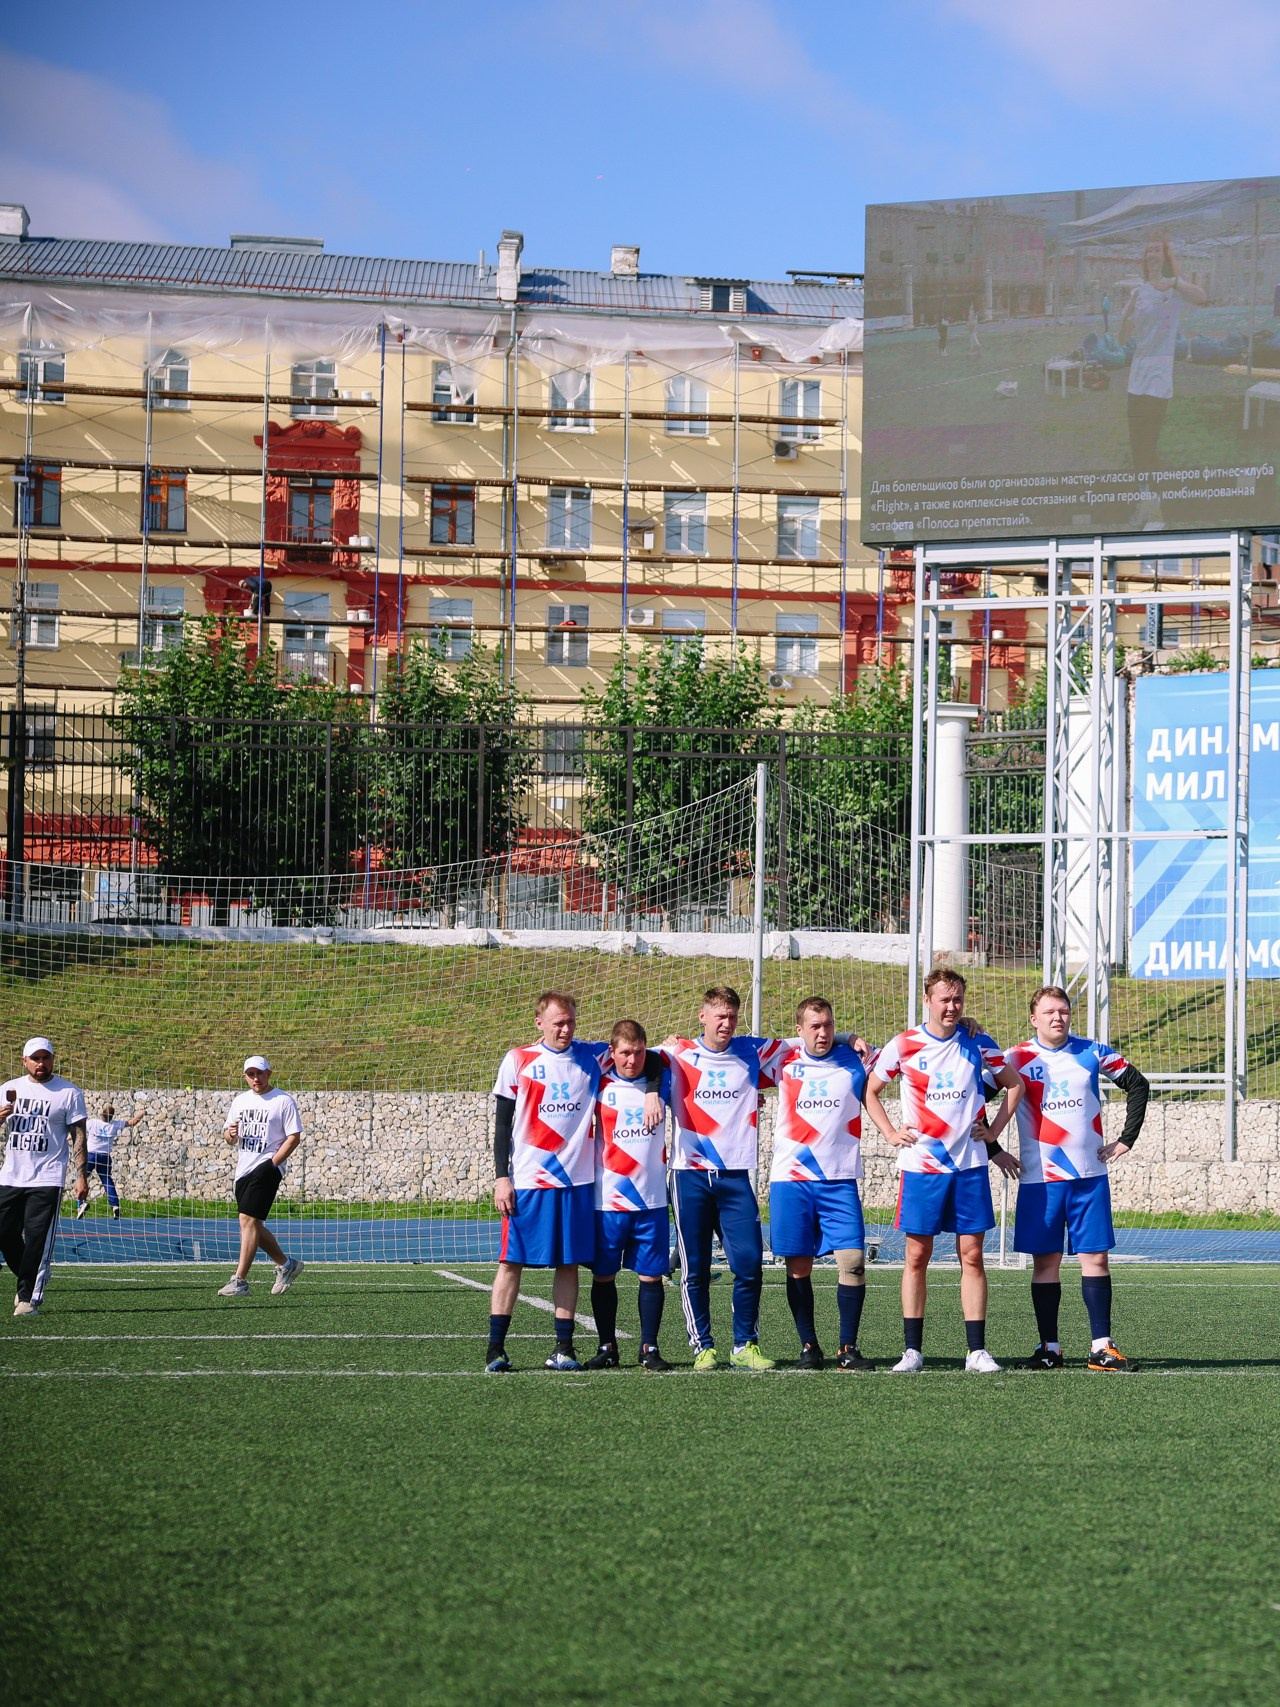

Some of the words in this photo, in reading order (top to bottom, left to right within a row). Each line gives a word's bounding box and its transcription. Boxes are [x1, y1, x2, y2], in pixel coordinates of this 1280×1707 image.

[871, 480, 890, 495] Для
[893, 479, 958, 493] болельщиков
[961, 476, 986, 489] были
[989, 474, 1059, 491] организованы
[1061, 470, 1136, 487] мастер-классы
[1138, 472, 1149, 481] от
[1152, 468, 1200, 483] тренеров
[1202, 463, 1274, 481] фитнес-клуба
[922, 500, 950, 510] также
[952, 497, 1018, 510] комплексные
[1021, 494, 1077, 506] состязания
[1080, 490, 1115, 506] «Тропа
[1162, 486, 1255, 501] комбинированная
[870, 520, 914, 533] эстафета
[916, 517, 959, 530] «Полоса
[962, 513, 1033, 530] препятствий».
[1146, 769, 1242, 801] МИЛ
[693, 1052, 701, 1066] 7
[918, 1056, 928, 1071] 6
[532, 1064, 546, 1080] 13
[792, 1063, 806, 1079] 15
[1029, 1065, 1044, 1081] 12
[607, 1092, 617, 1106] 9
[694, 1090, 739, 1099] КОМОС
[926, 1089, 967, 1101] КОМОС
[13, 1098, 52, 1117] NJOY
[539, 1102, 582, 1113] КОМОС
[796, 1098, 841, 1110] КОМОС
[1041, 1098, 1084, 1111] КОМОС
[613, 1127, 657, 1139] КОМОС
[9, 1133, 49, 1152] LIGHT
